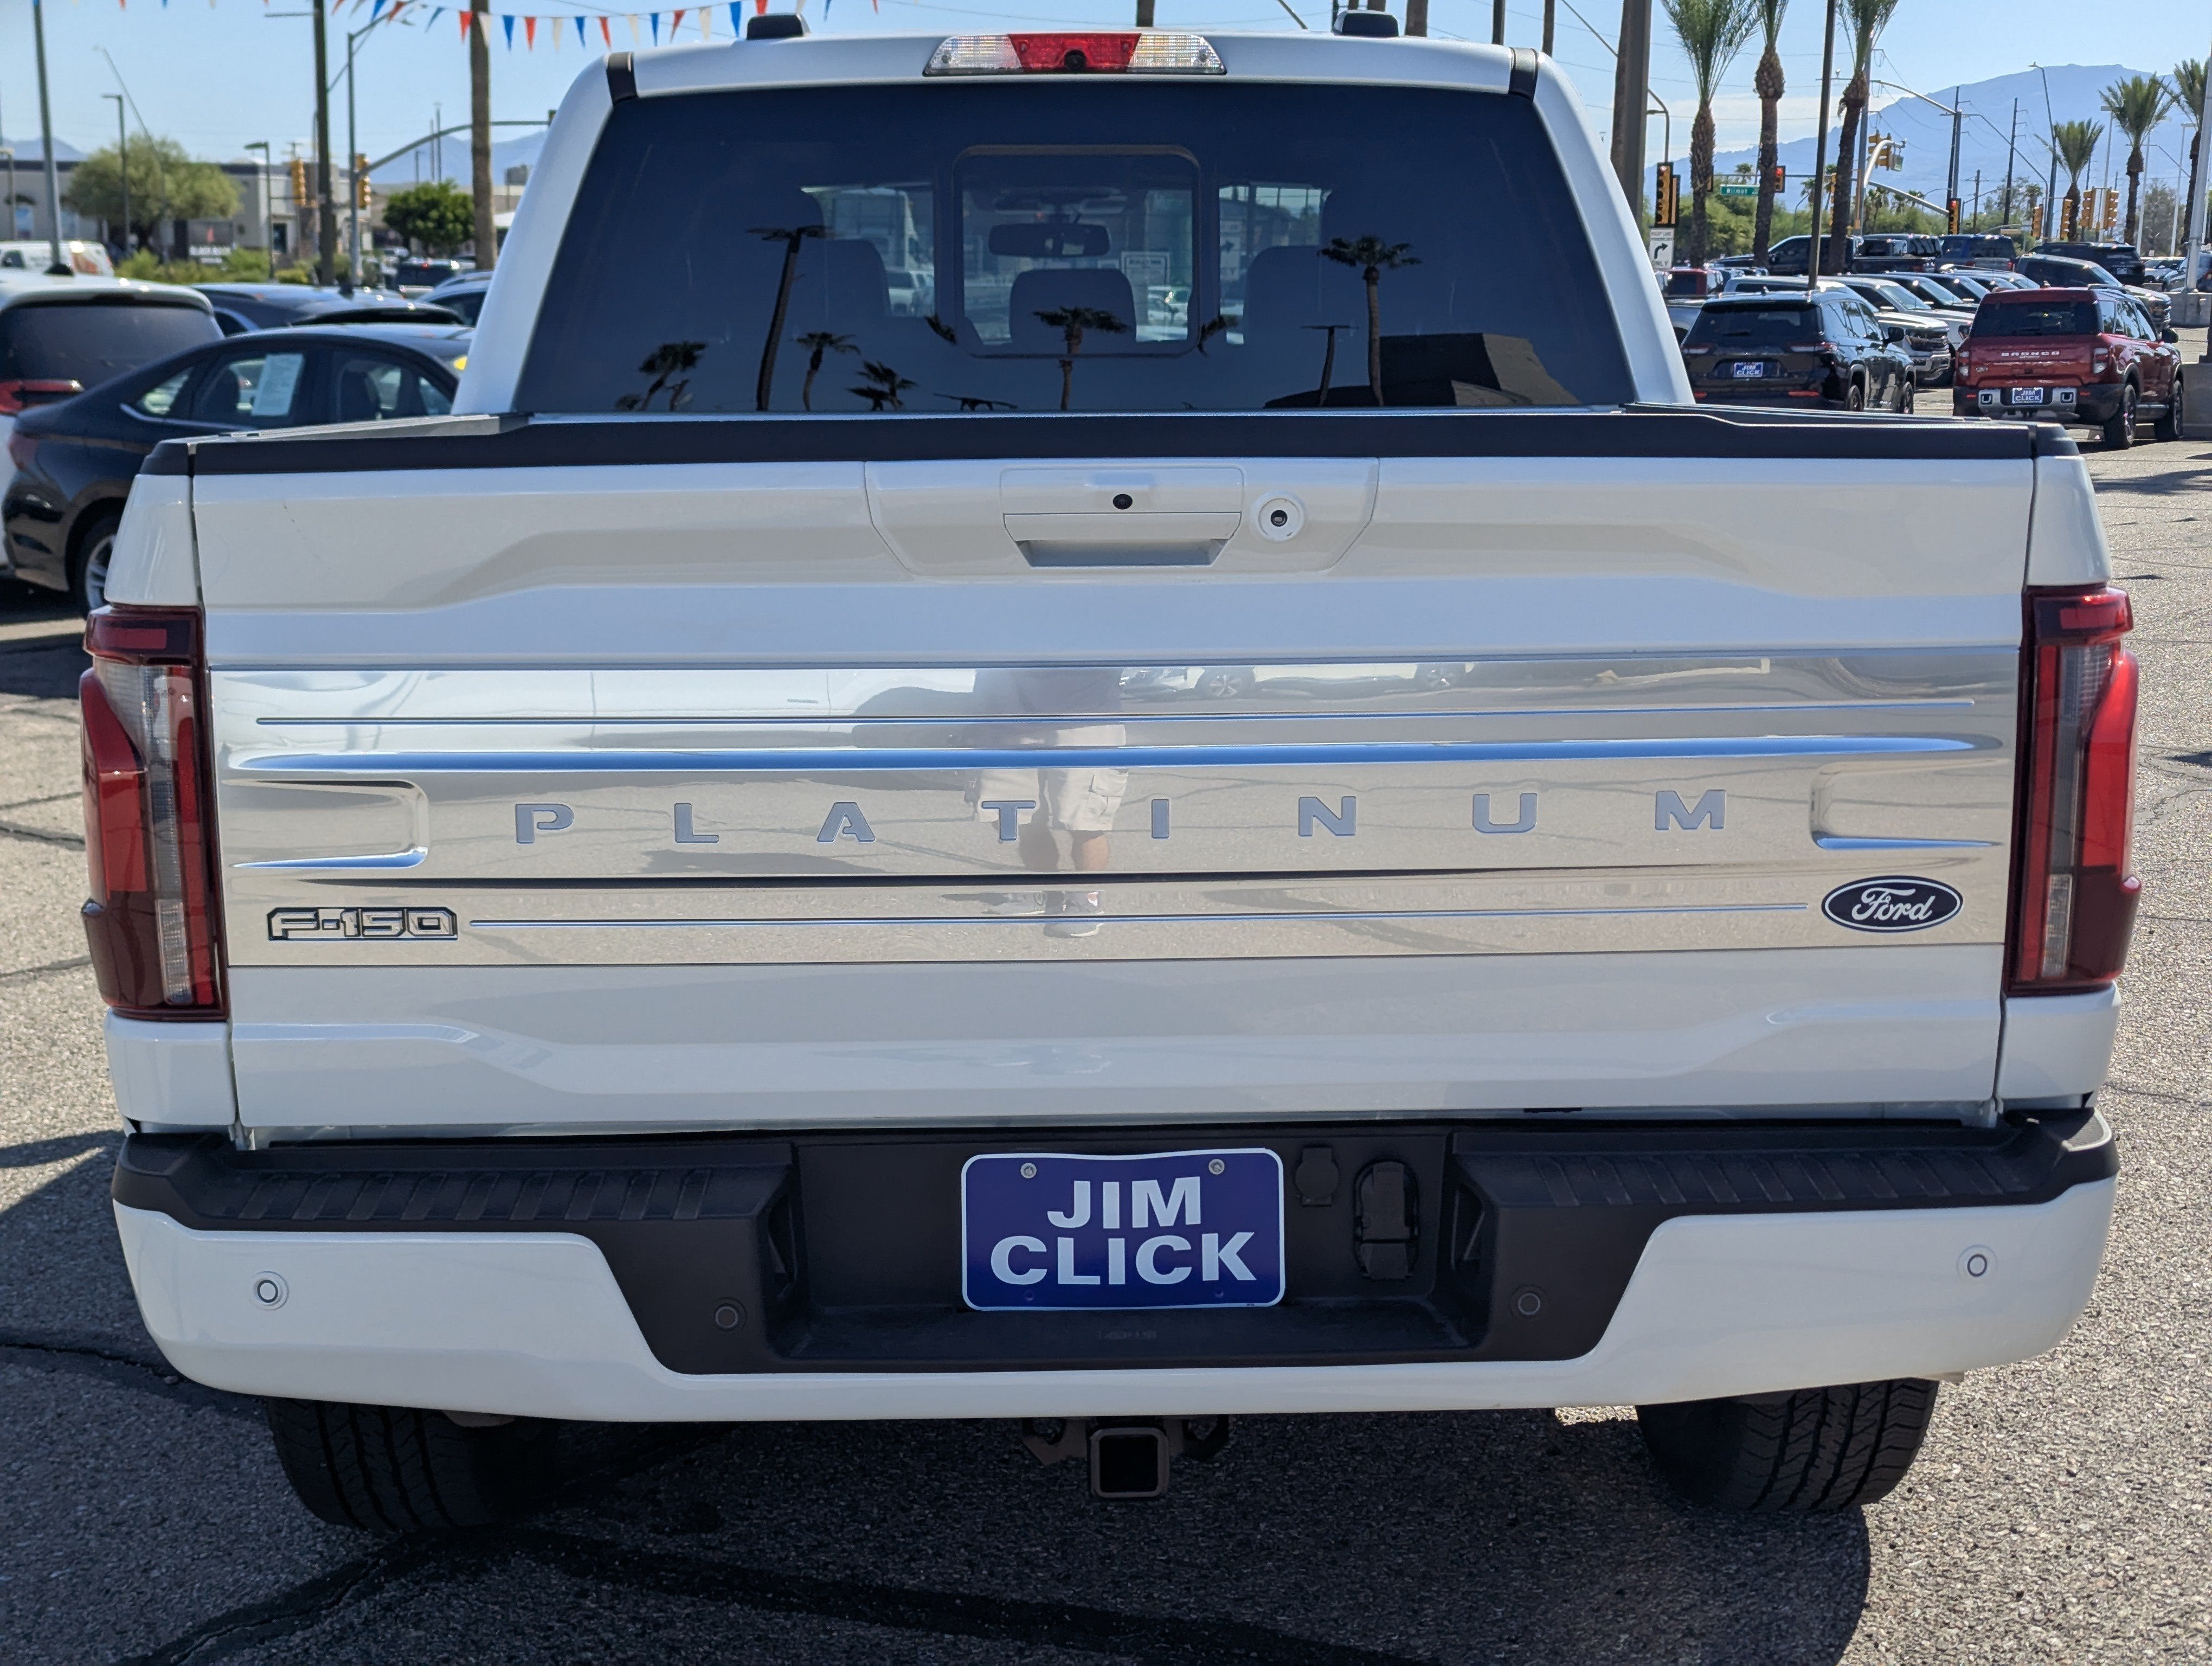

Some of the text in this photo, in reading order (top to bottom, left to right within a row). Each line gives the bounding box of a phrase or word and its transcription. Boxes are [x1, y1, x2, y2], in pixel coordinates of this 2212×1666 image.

[515, 790, 1726, 844] PLATINUM
[267, 907, 458, 941] F-150
[1851, 887, 1936, 921] Ford
[1047, 1176, 1201, 1229] JIM
[991, 1232, 1257, 1285] CLICK
